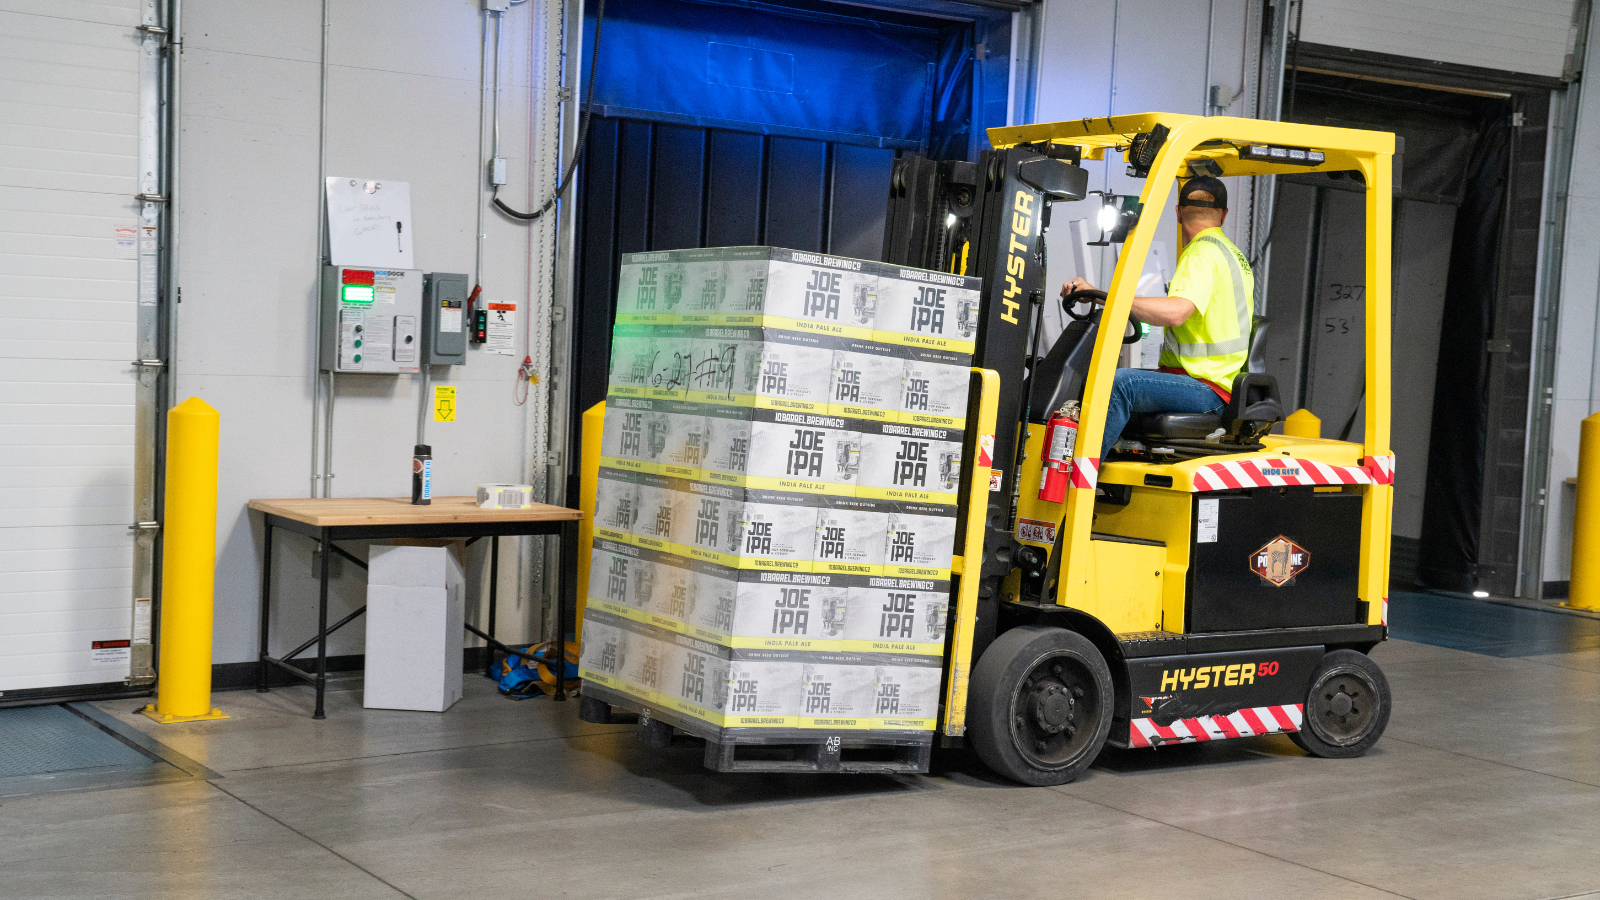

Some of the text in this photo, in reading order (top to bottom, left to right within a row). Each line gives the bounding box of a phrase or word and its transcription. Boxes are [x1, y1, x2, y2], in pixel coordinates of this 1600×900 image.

[1000, 190, 1034, 326] HYSTER
[806, 270, 843, 294] JOE
[913, 286, 947, 308] JOE
[1330, 283, 1366, 301] 327
[803, 291, 840, 320] IPA
[796, 322, 814, 330] INDIA
[816, 324, 830, 332] PALE
[910, 306, 945, 334] IPA
[903, 336, 920, 344] INDIA
[922, 338, 936, 346] PALE
[764, 361, 788, 377] JOE
[838, 369, 862, 385] JOE
[762, 376, 787, 395] IPA
[836, 383, 860, 402] IPA
[907, 378, 930, 394] JOE
[904, 392, 928, 410] IPA
[789, 428, 826, 450] JOE
[896, 440, 930, 462] JOE
[786, 450, 823, 478] IPA
[1262, 468, 1300, 476] RIDE RITE
[892, 461, 927, 488] IPA
[779, 480, 796, 488] INDIA
[748, 522, 772, 536] JOE
[822, 526, 846, 542] JOE
[746, 536, 771, 554] IPA
[892, 531, 915, 546] JOE
[820, 540, 844, 559] IPA
[890, 545, 914, 562] IPA
[775, 588, 812, 610] JOE
[882, 592, 916, 614] JOE
[772, 609, 808, 636] IPA
[880, 613, 914, 638] IPA
[872, 642, 890, 650] INDIA
[1160, 661, 1280, 692] HYSTER 50
[734, 680, 758, 694] JOE
[808, 682, 832, 696] JOE
[878, 684, 900, 698] JOE
[732, 694, 757, 712] IPA
[806, 696, 830, 714] IPA
[876, 698, 899, 714] IPA
